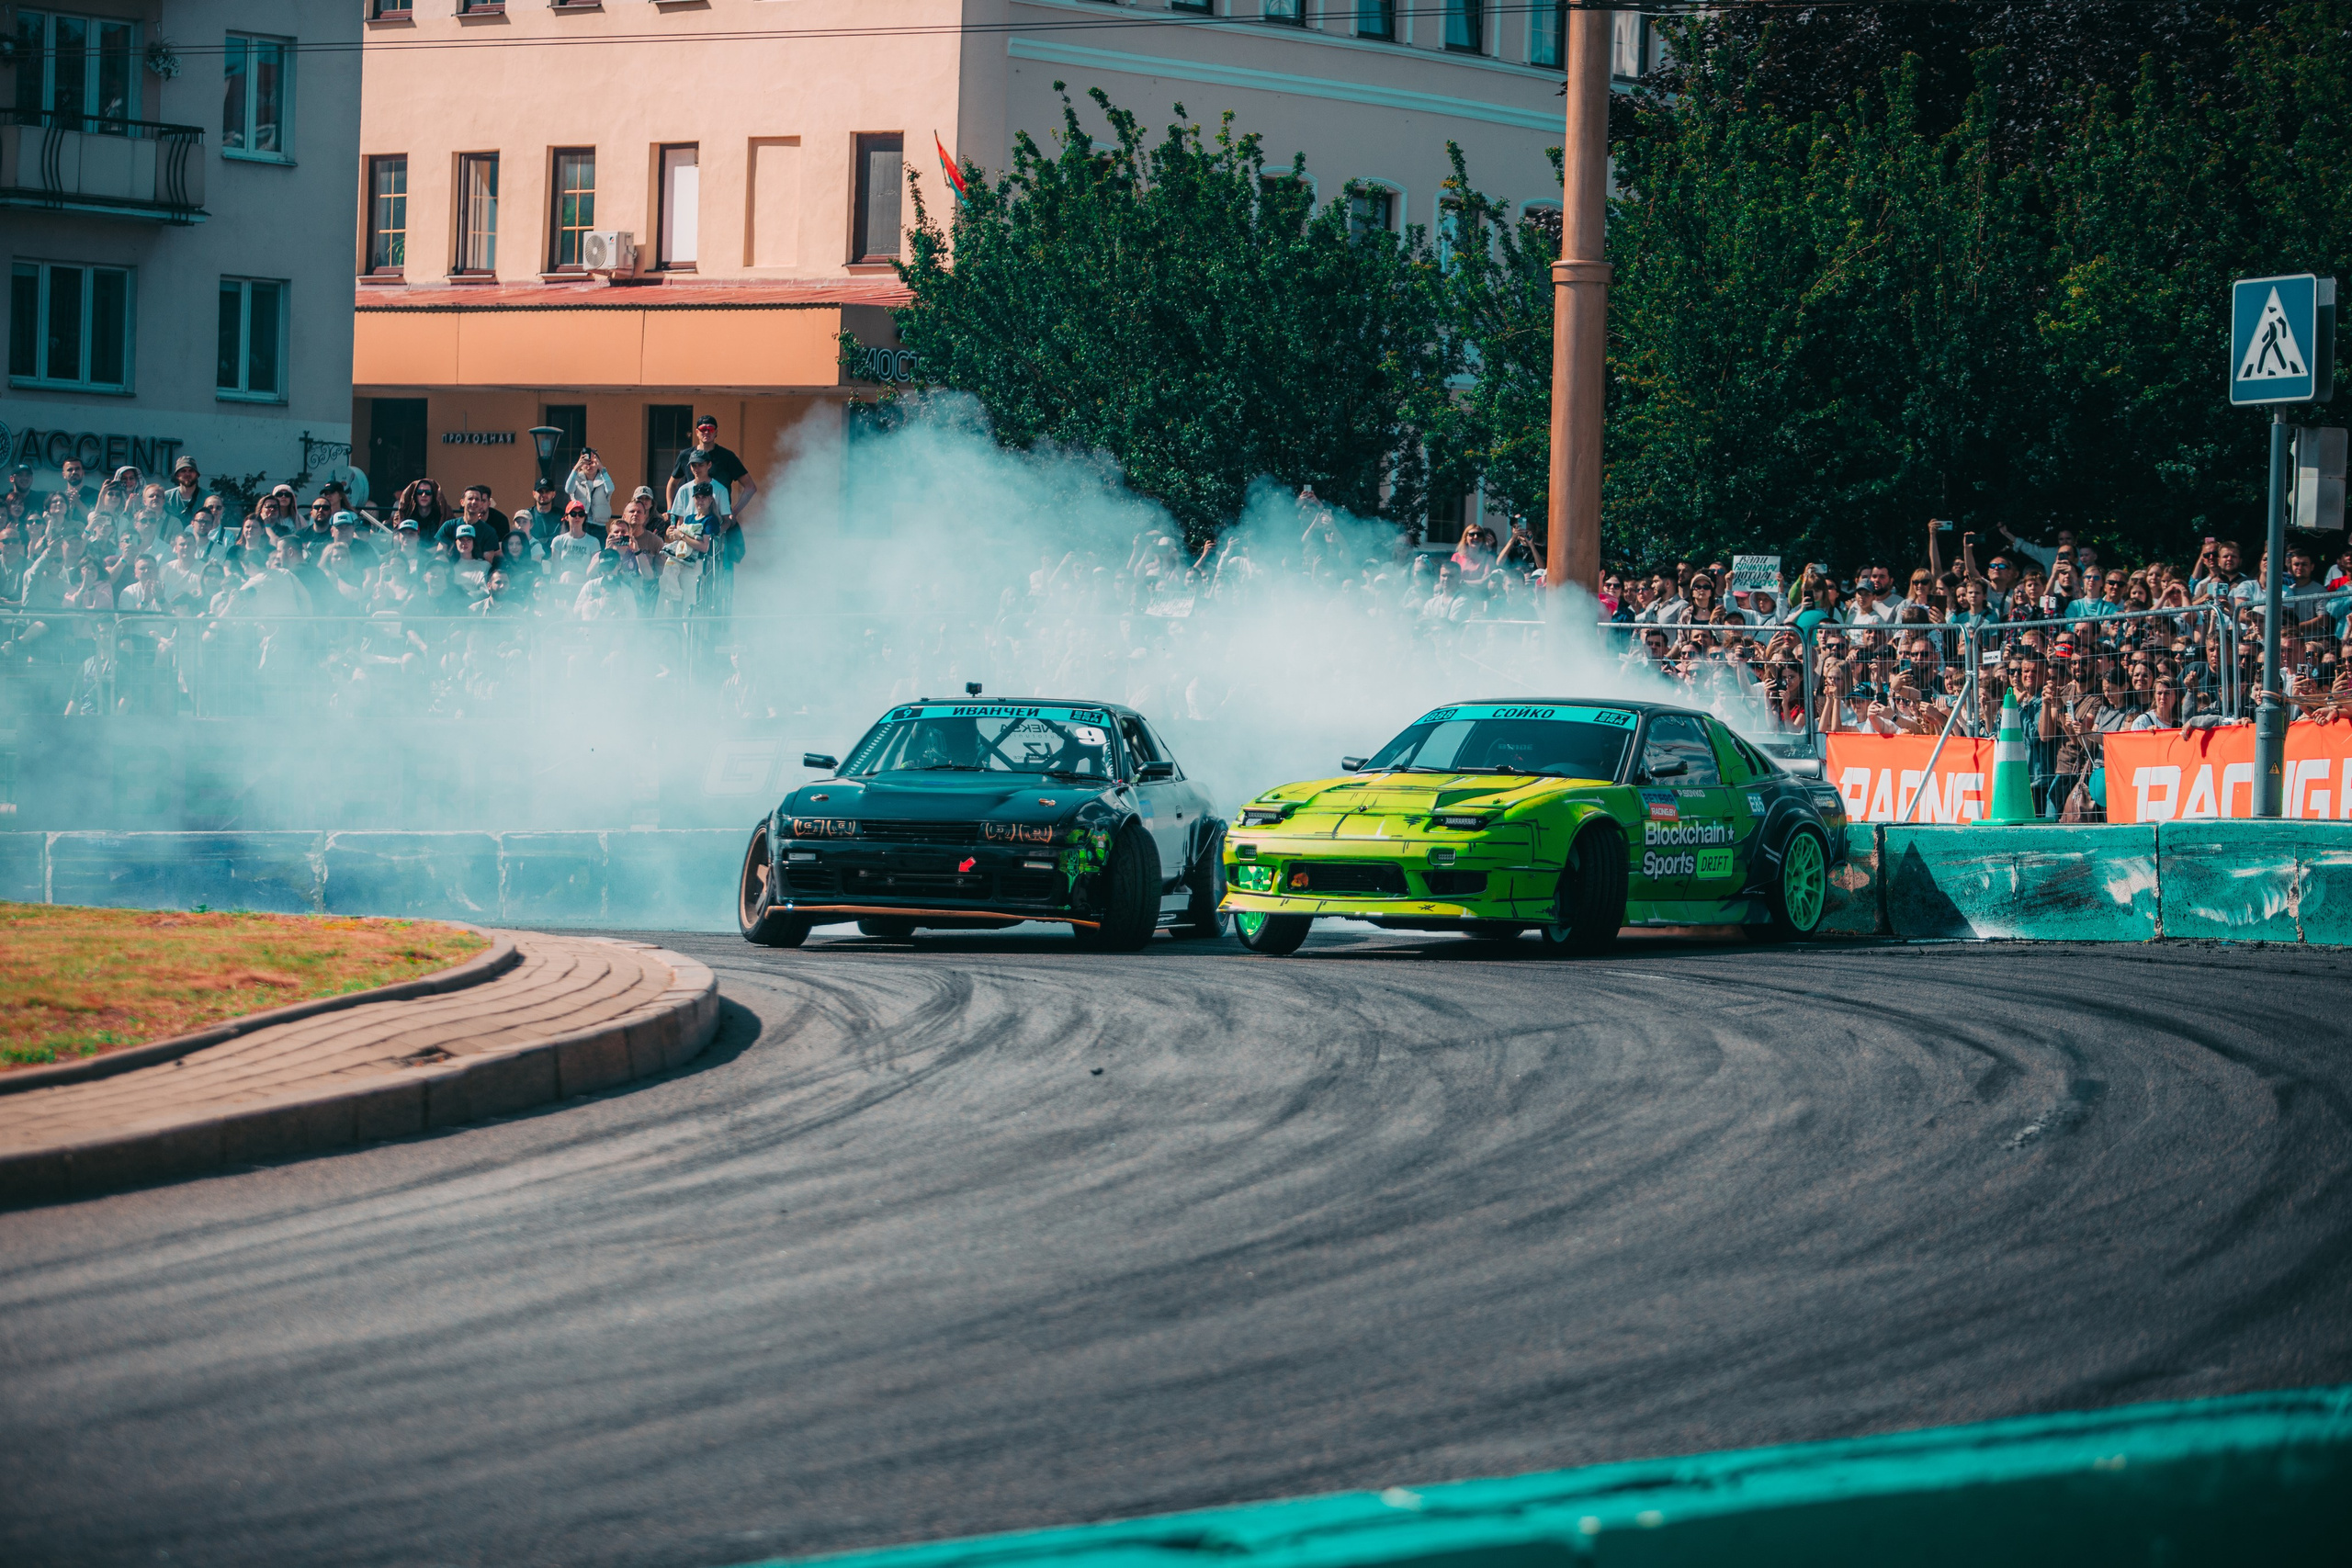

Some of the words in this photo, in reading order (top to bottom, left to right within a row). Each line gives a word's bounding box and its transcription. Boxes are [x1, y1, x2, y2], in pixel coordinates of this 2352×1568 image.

[442, 433, 512, 445] ПРОХОДНАЯ
[17, 428, 183, 478] ACCENT
[903, 709, 913, 718] 9
[1427, 709, 1456, 721] 888
[1492, 706, 1555, 718] СОЙКО
[1075, 727, 1107, 745] 9
[1839, 767, 1984, 822] RACING
[1747, 796, 1765, 812] E85
[1645, 820, 1724, 845] Blockchain
[1644, 852, 1694, 880] Sports
[1701, 855, 1729, 872] DRIFT
